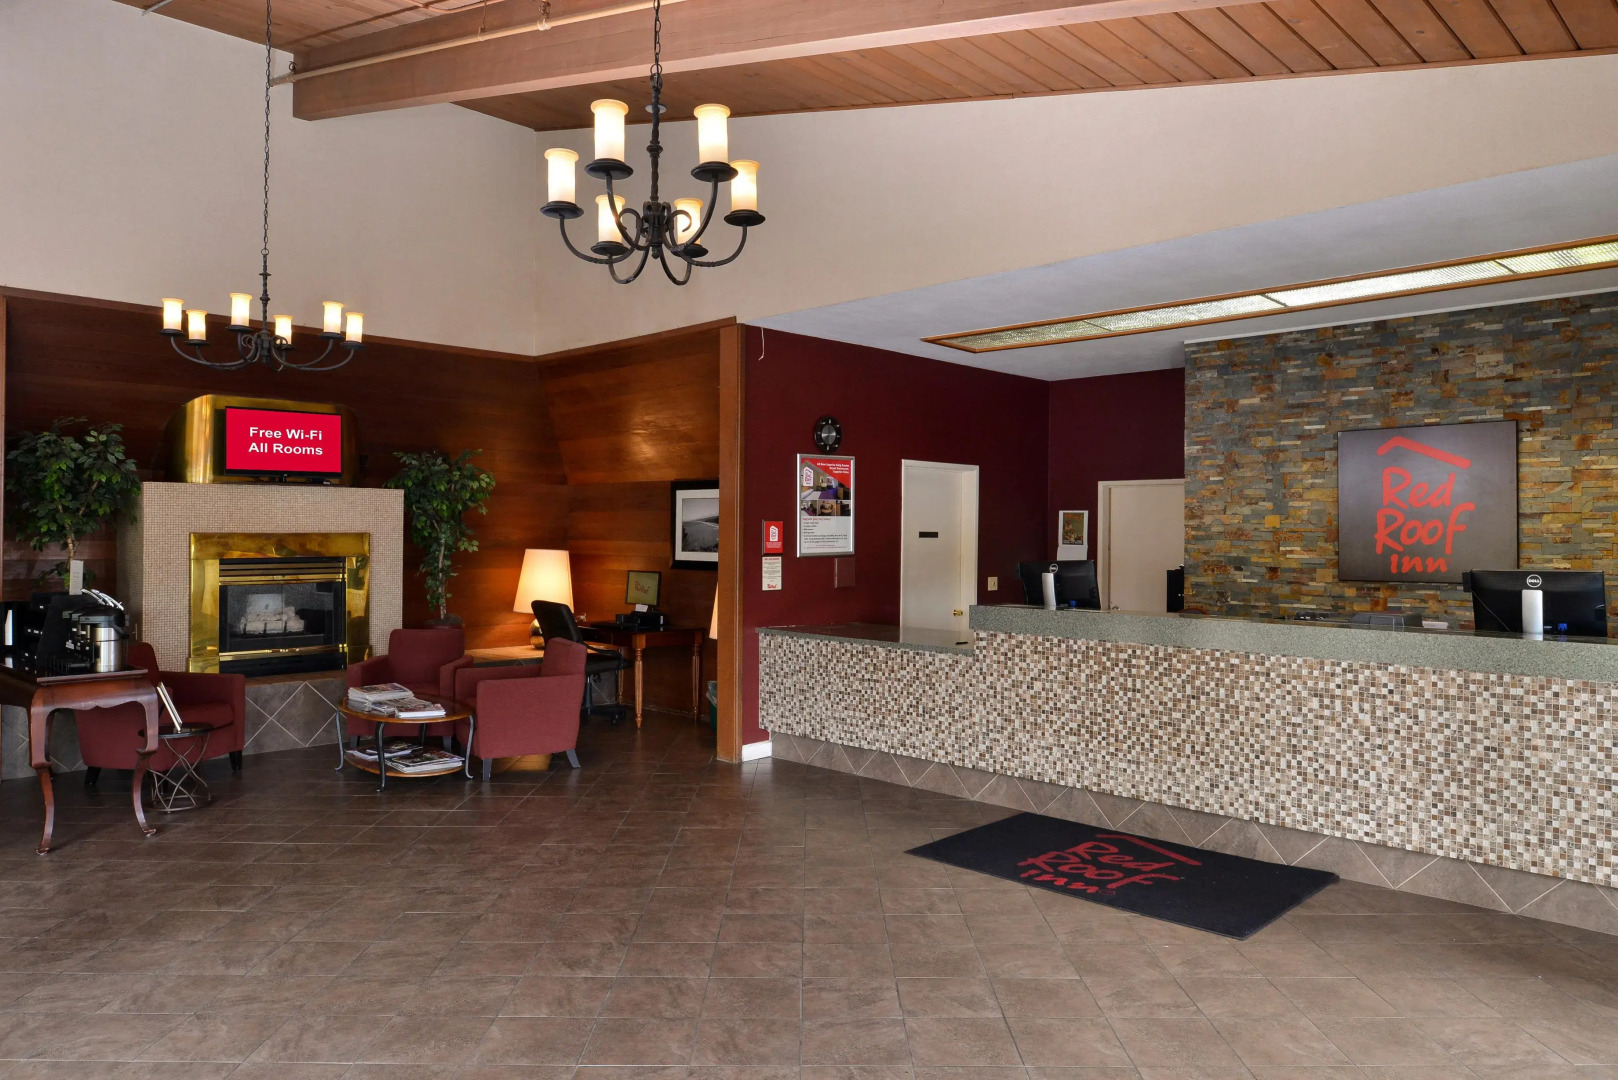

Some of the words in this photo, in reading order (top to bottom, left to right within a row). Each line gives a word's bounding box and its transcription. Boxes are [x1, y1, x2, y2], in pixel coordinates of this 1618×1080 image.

[248, 442, 268, 453] All
[272, 443, 323, 456] Rooms
[249, 426, 282, 439] Free
[286, 428, 323, 441] Wi-Fi
[1381, 466, 1456, 509] Red
[1373, 502, 1476, 555] Roof
[1016, 850, 1181, 889] Roof
[1064, 841, 1175, 872] Red
